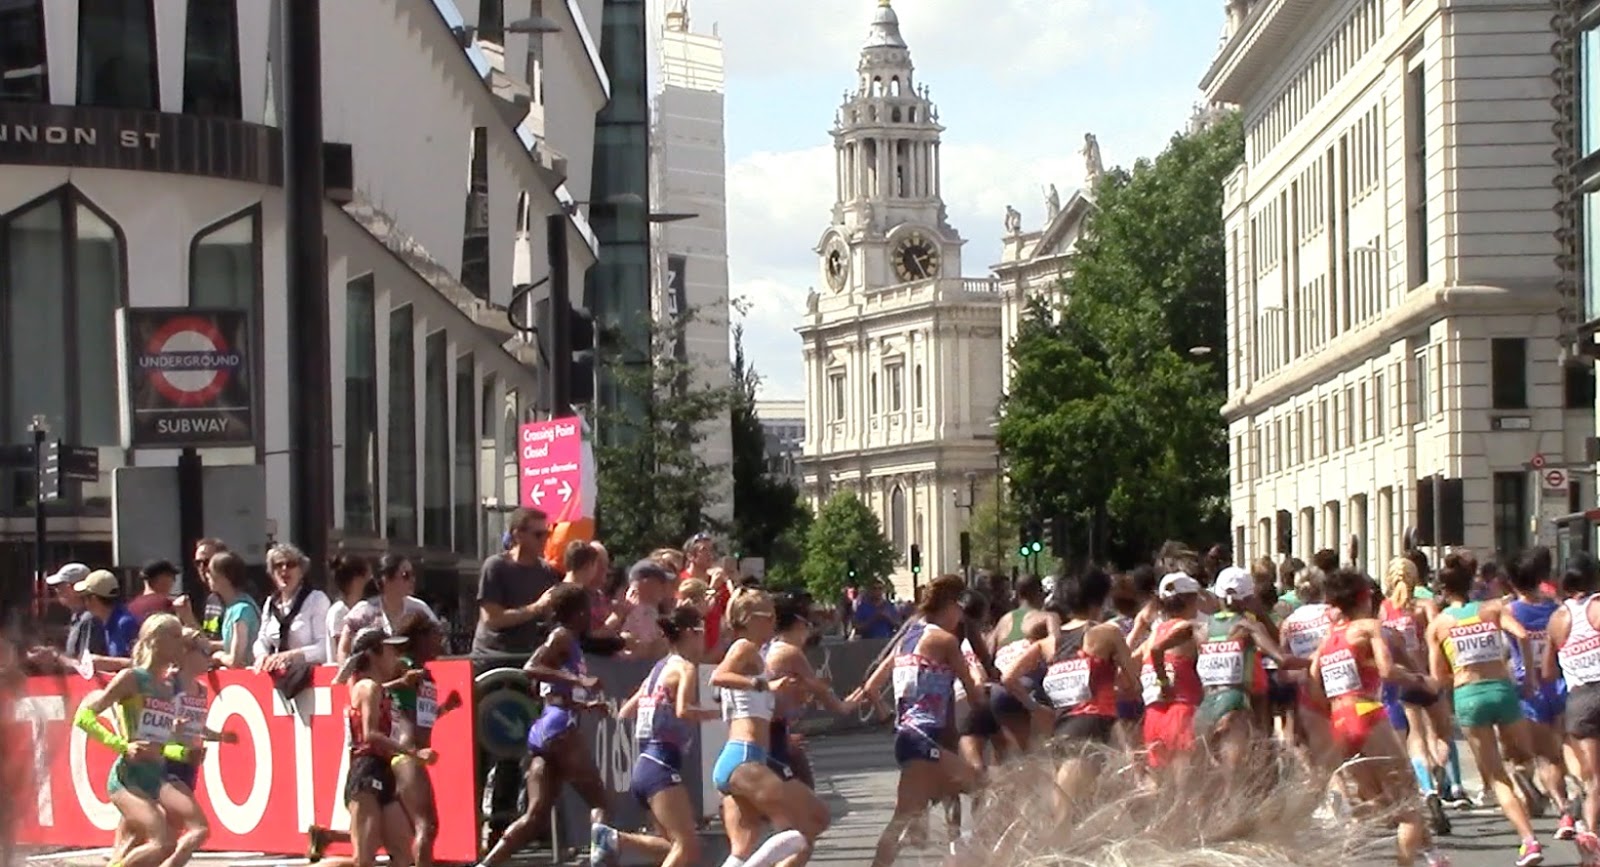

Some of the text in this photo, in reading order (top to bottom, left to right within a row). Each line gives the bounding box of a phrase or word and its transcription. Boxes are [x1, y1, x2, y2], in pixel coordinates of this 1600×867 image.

[120, 130, 161, 149] ST
[139, 355, 239, 368] UNDERGROUND
[158, 418, 228, 434] SUBWAY
[523, 424, 575, 442] Crossing Point
[523, 443, 548, 459] Closed
[1450, 622, 1498, 637] TOYOTA
[1200, 641, 1241, 654] TOYOTA
[1457, 634, 1496, 652] DIVER
[1047, 658, 1090, 676] TOYOTA
